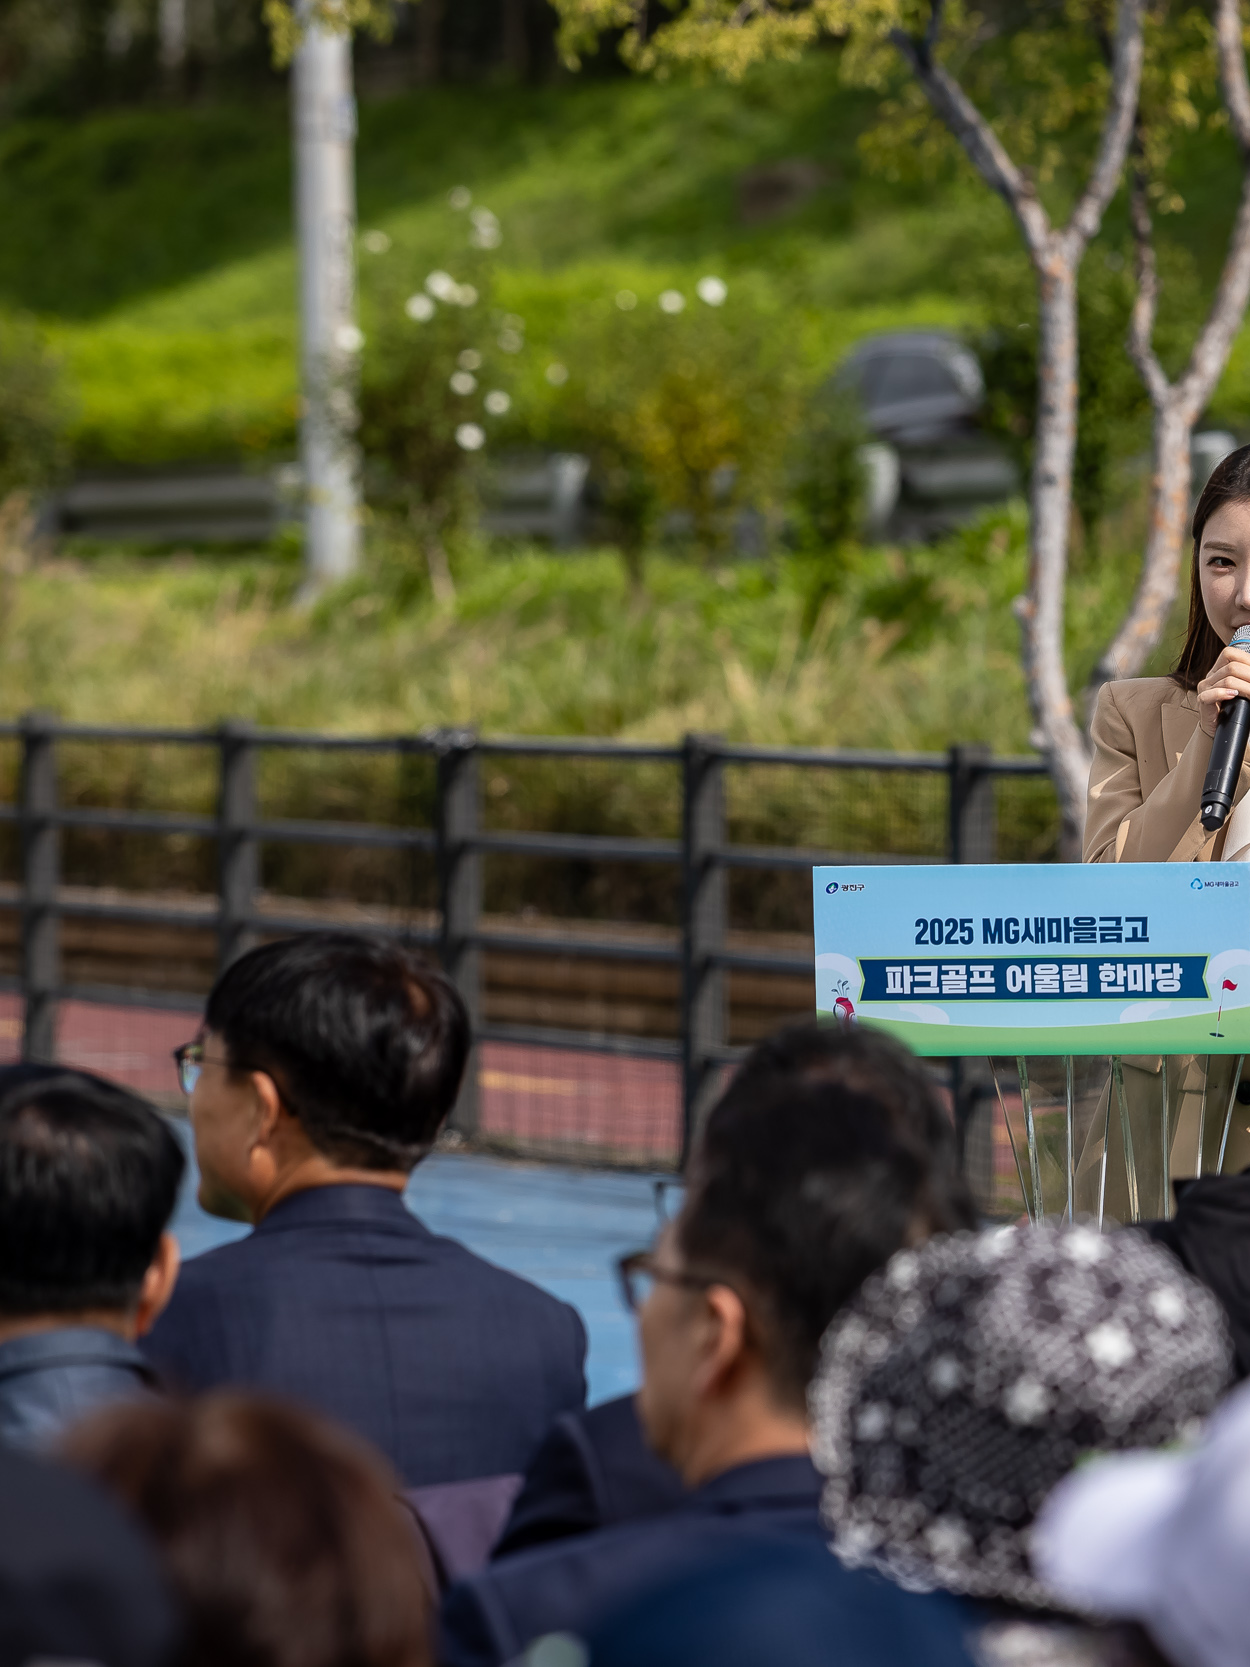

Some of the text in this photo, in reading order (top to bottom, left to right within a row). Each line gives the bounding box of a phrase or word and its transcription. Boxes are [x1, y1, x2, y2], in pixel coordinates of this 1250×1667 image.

[841, 884, 865, 892] 광진구
[915, 917, 1150, 945] 2025 MG새마을금고
[885, 962, 1183, 995] 파크골프 어울림 한마당
